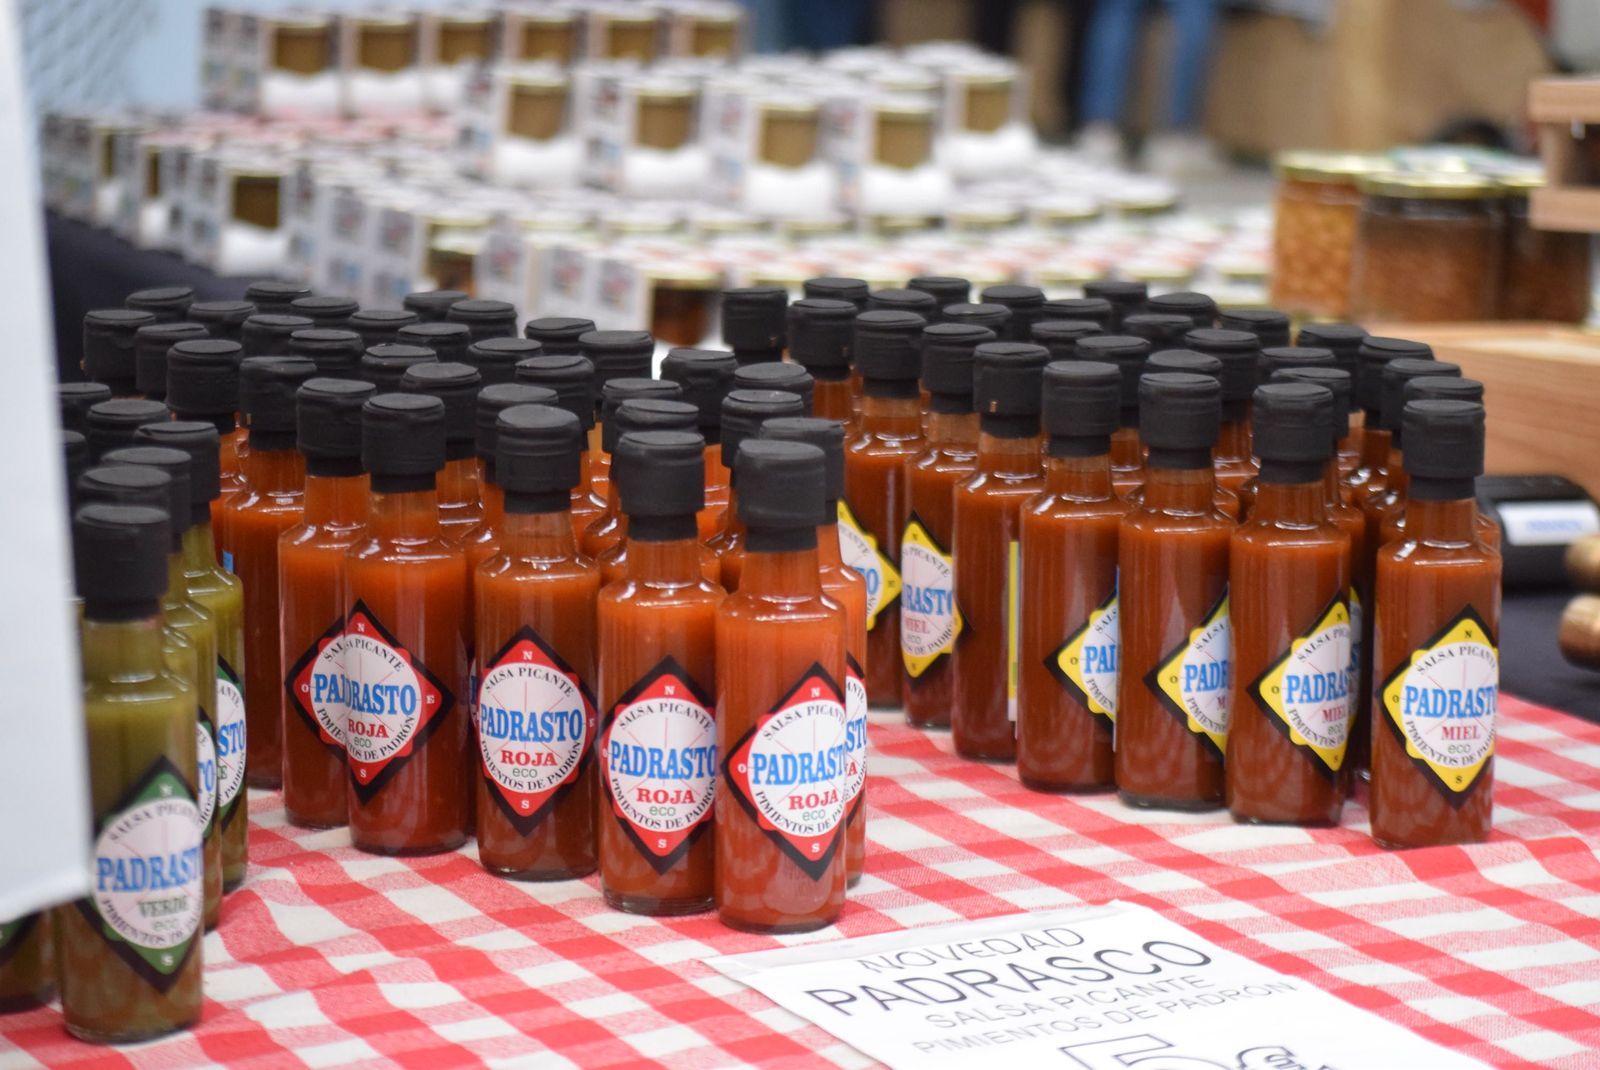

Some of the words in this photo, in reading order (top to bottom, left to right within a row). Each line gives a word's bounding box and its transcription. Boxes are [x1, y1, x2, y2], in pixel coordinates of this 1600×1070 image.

[355, 638, 405, 672] PICANTE
[523, 651, 533, 660] N
[1416, 649, 1455, 675] SALSA
[485, 669, 515, 693] SALSA
[519, 667, 575, 697] PICANTE
[664, 685, 675, 696] N
[811, 687, 821, 697] N
[481, 704, 583, 742] PADRASTO
[619, 705, 654, 730] SALSA
[659, 702, 713, 732] PICANTE
[763, 710, 802, 740] SALSA
[348, 718, 389, 738] ROJA
[1441, 725, 1481, 741] MIEL
[354, 736, 372, 748] eco
[1405, 720, 1459, 766] PIMIENTOS
[1447, 743, 1472, 755] eco
[481, 741, 524, 790] PIMIENTOS
[528, 779, 546, 791] DE
[501, 750, 558, 766] ROJA
[610, 740, 717, 780] PADRASTO
[359, 768, 367, 778] S
[512, 767, 538, 778] eco
[521, 800, 529, 809] S
[612, 778, 662, 830] PIMIENTOS
[666, 818, 684, 830] DE
[637, 788, 696, 805] ROJA
[789, 790, 839, 810] ROJA
[649, 805, 676, 816] eco
[755, 791, 813, 834] PIMIENTOS
[817, 820, 831, 834] DE
[802, 808, 826, 821] eco
[658, 839, 667, 849] S
[811, 842, 820, 853] S
[857, 928, 1085, 973] NOVEDAD
[803, 940, 1212, 1016] PADRASCO
[925, 1001, 1056, 1029] SALSA
[1050, 975, 1215, 1010] PICANTE
[912, 1016, 1103, 1054] PIMIENTOS
[1103, 1005, 1158, 1025] DE
